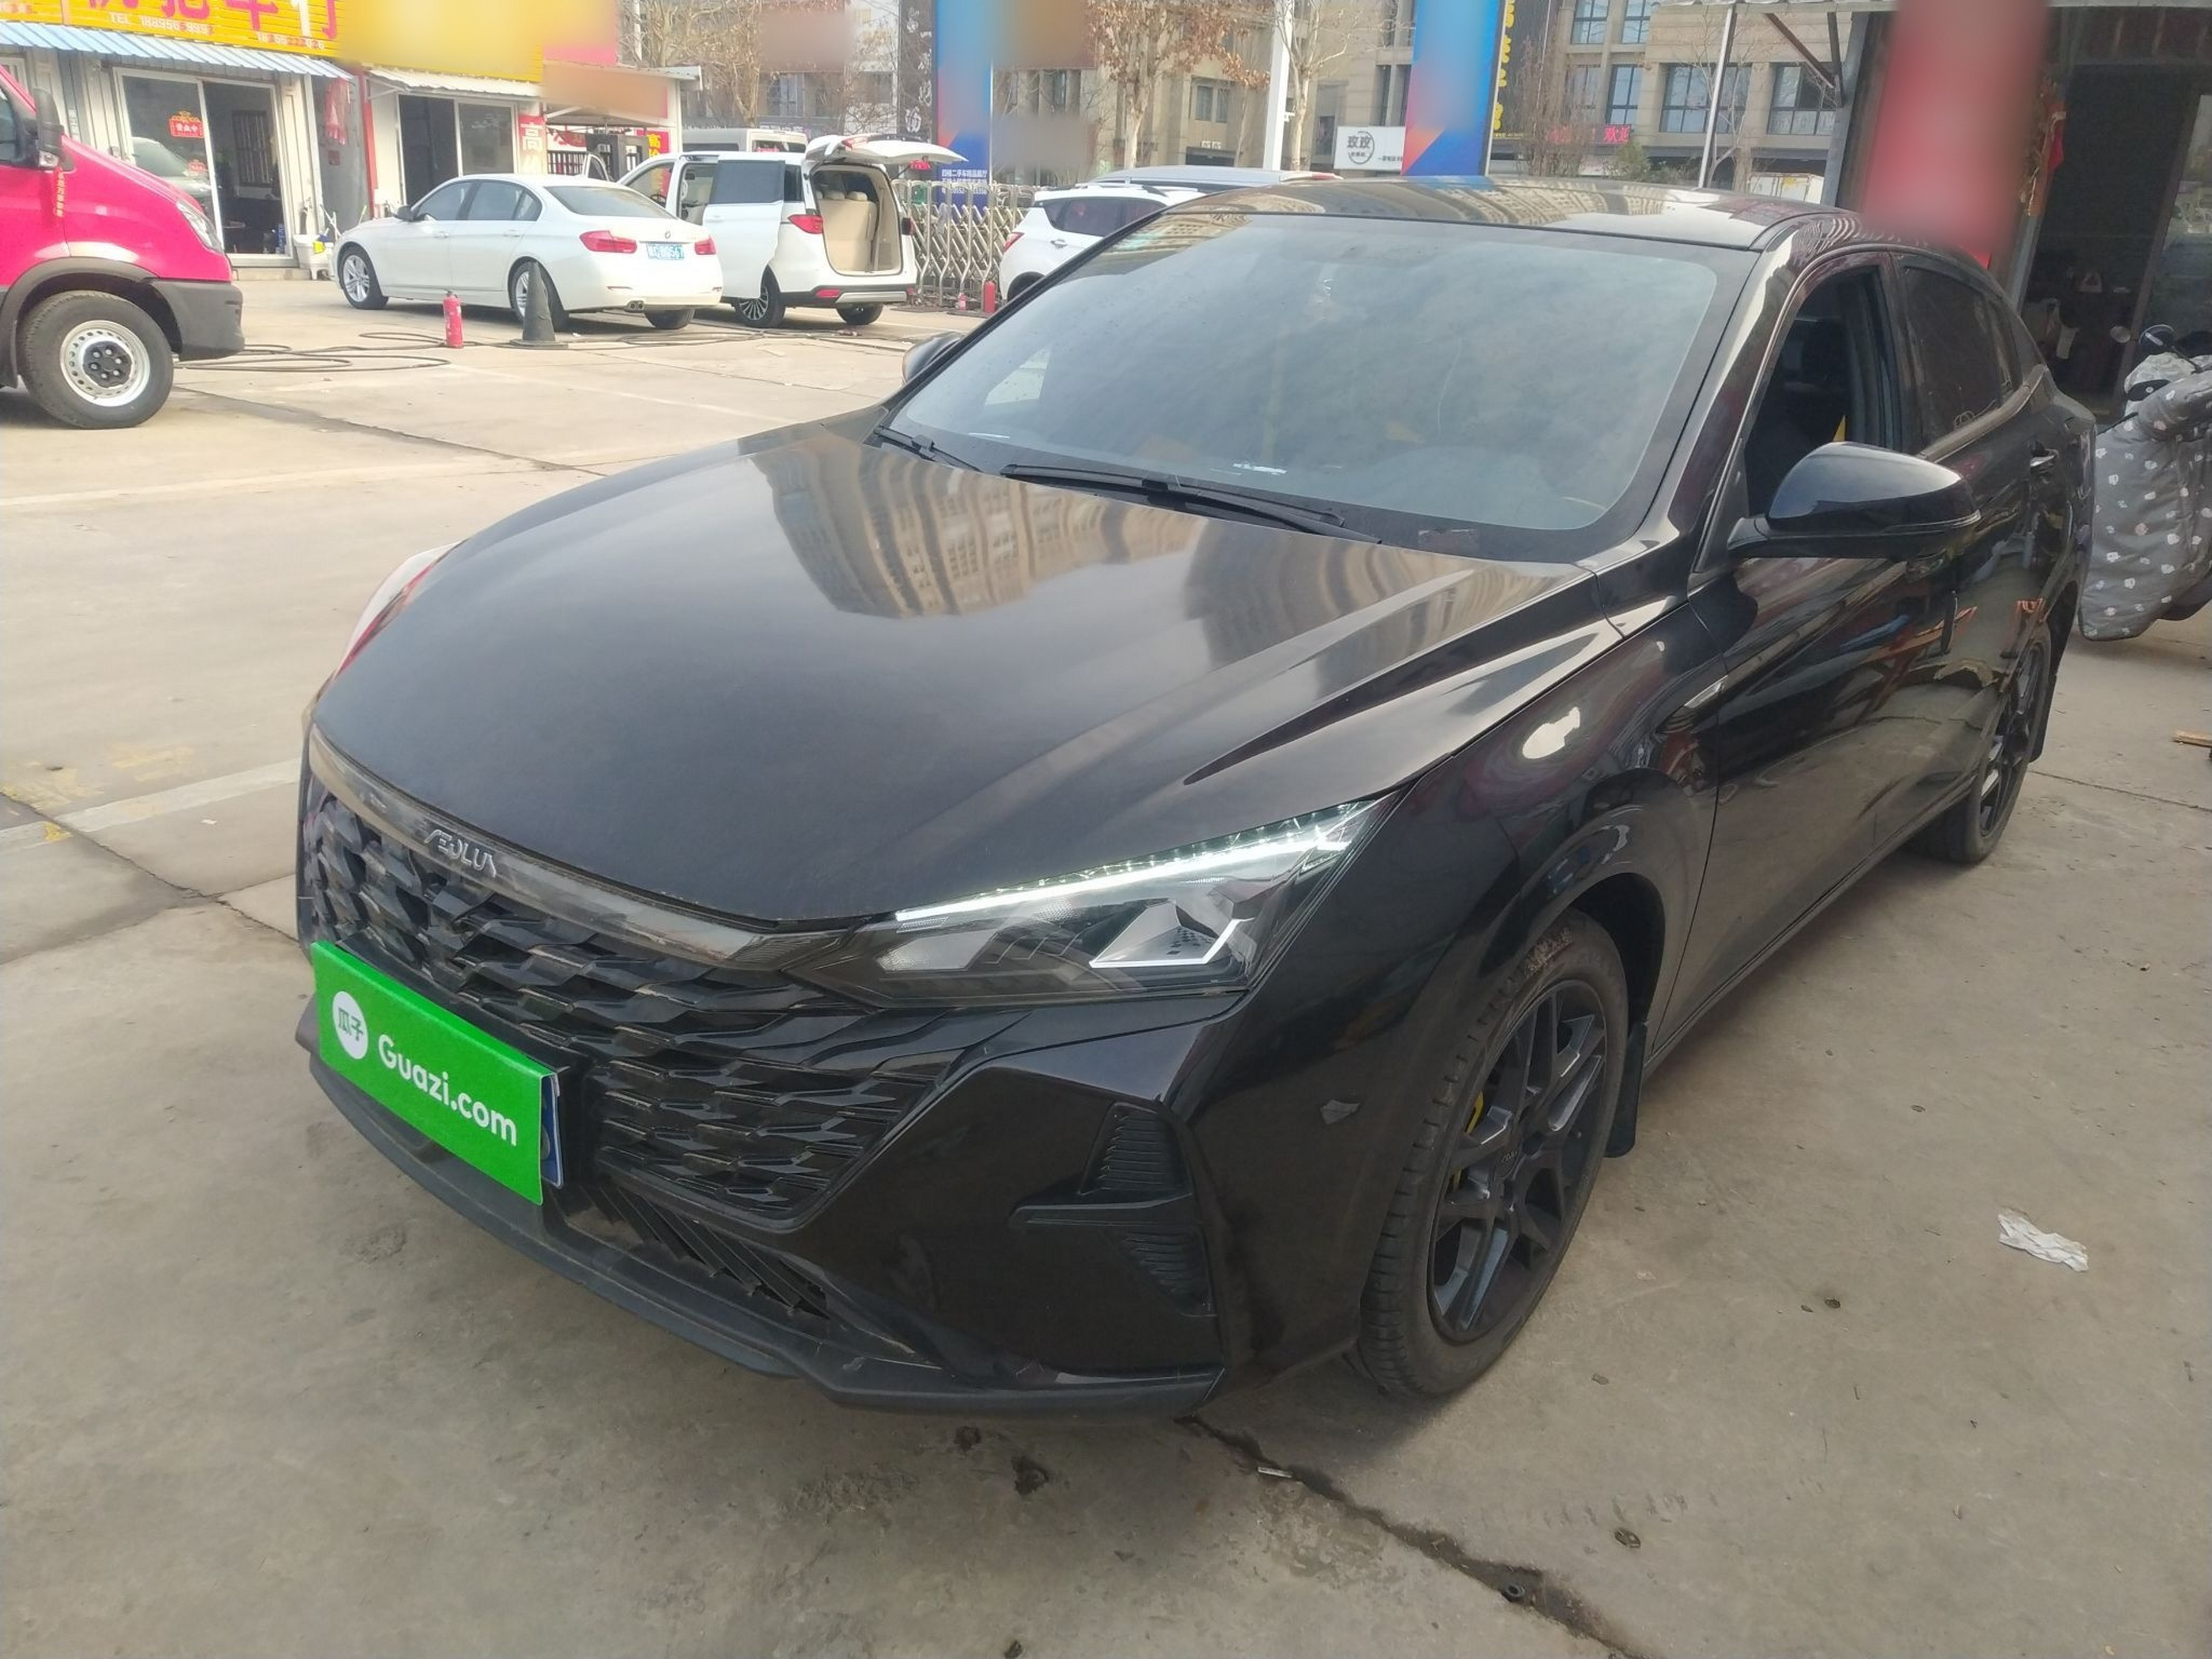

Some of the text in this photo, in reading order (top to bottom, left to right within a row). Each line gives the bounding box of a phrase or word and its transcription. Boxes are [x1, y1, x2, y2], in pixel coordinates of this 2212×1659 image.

[109, 12, 131, 25] TEL
[338, 1006, 363, 1042] 瓜子
[378, 1033, 517, 1146] Guazi.com
